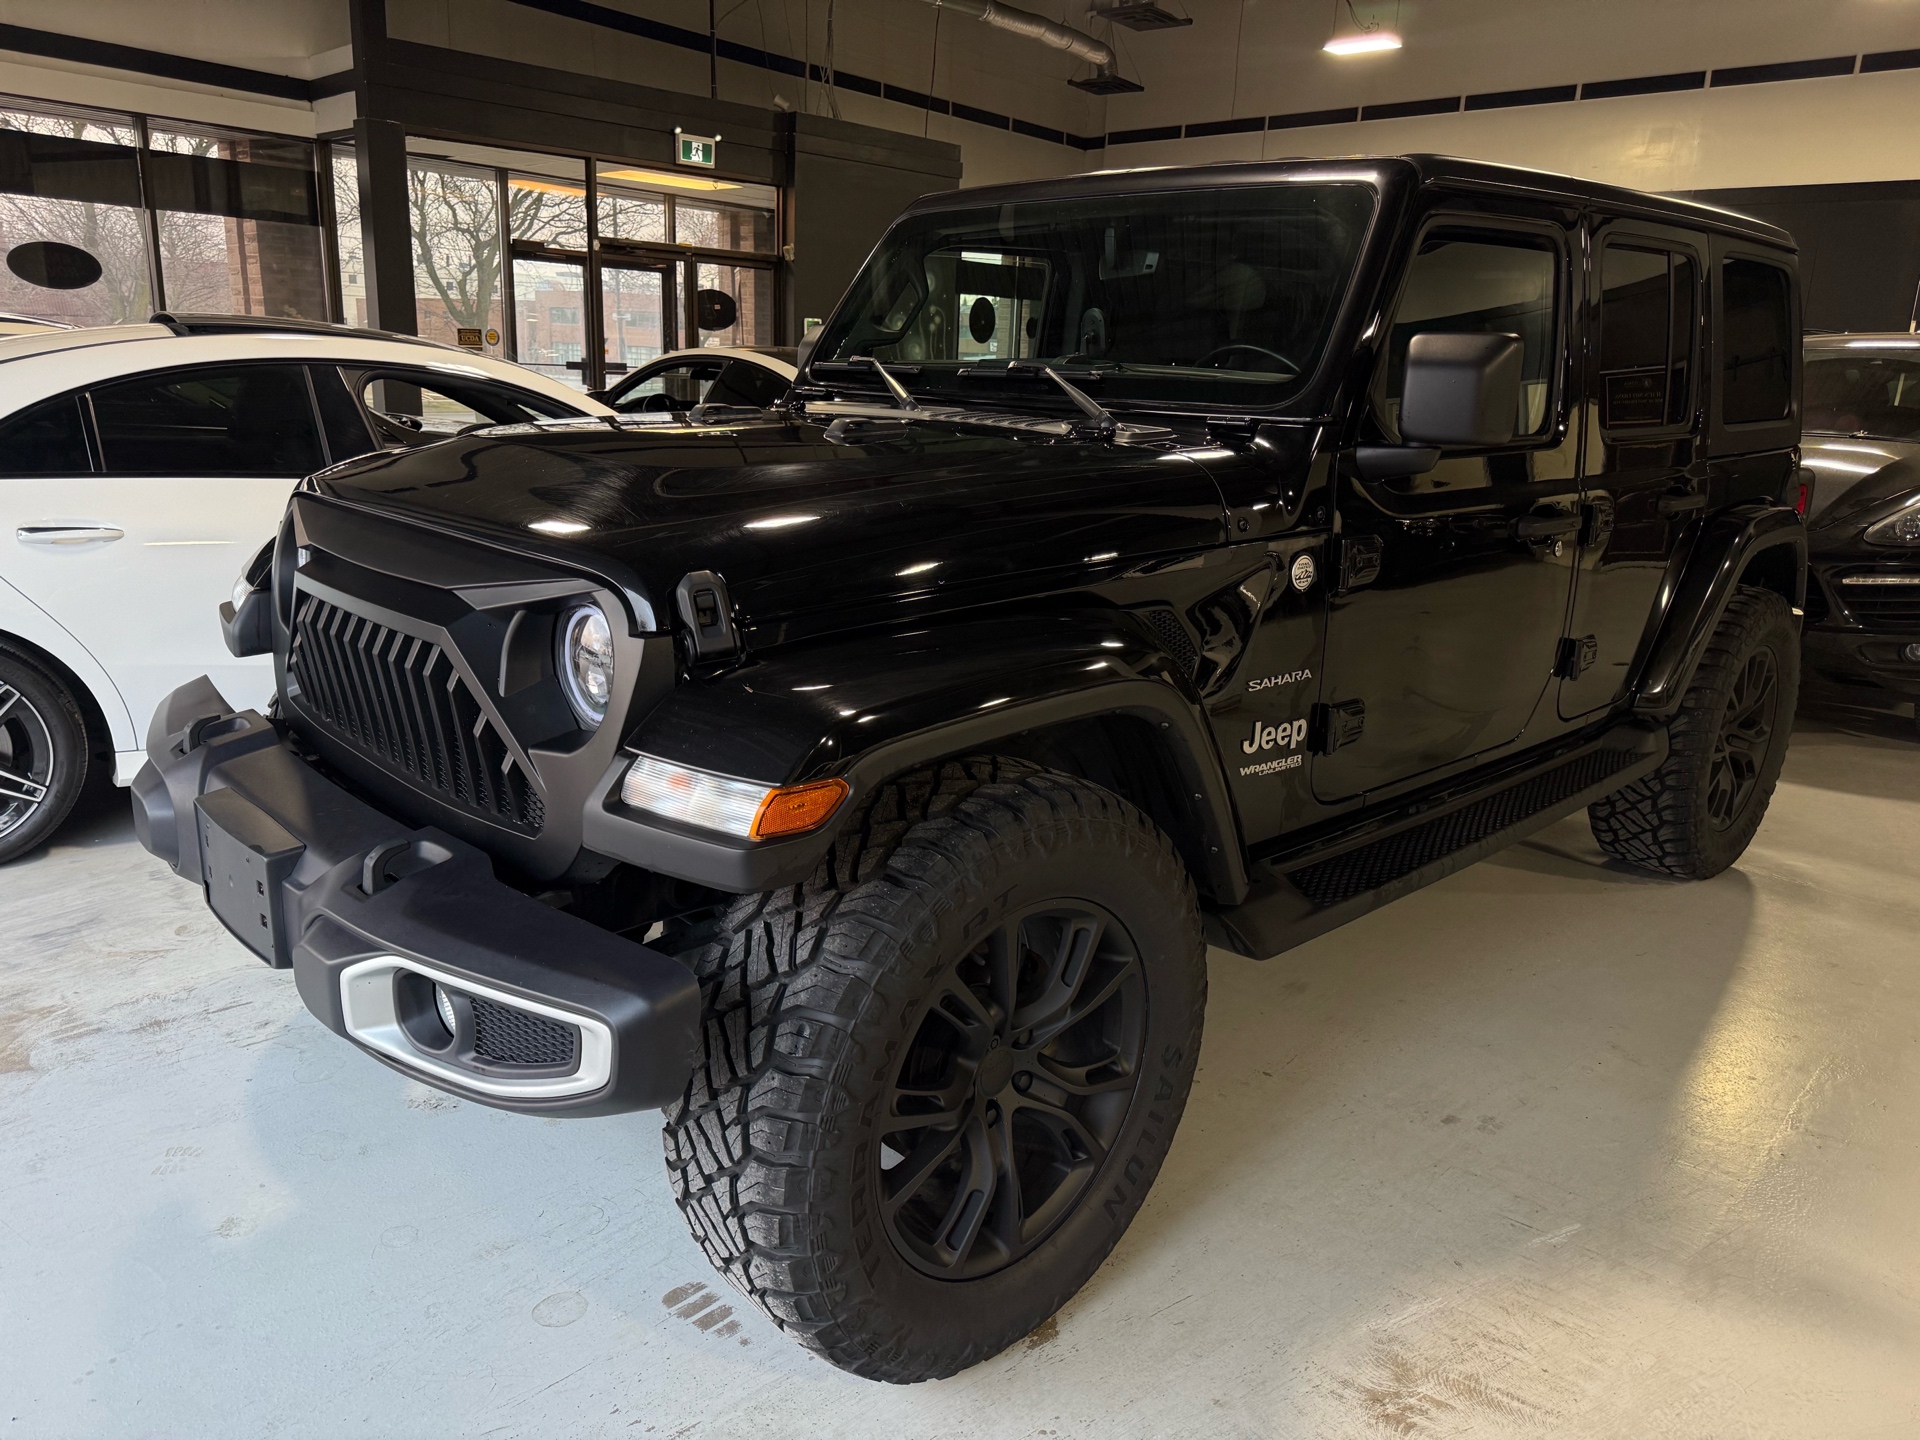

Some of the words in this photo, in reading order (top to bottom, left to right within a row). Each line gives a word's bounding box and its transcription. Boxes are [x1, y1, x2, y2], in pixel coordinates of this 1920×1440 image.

[1247, 669, 1312, 692] SAHARA
[1242, 718, 1307, 755] Jeep
[1240, 754, 1302, 776] WRANGLER
[1258, 762, 1302, 776] UNLIMITED
[1102, 1044, 1183, 1221] SAILUN
